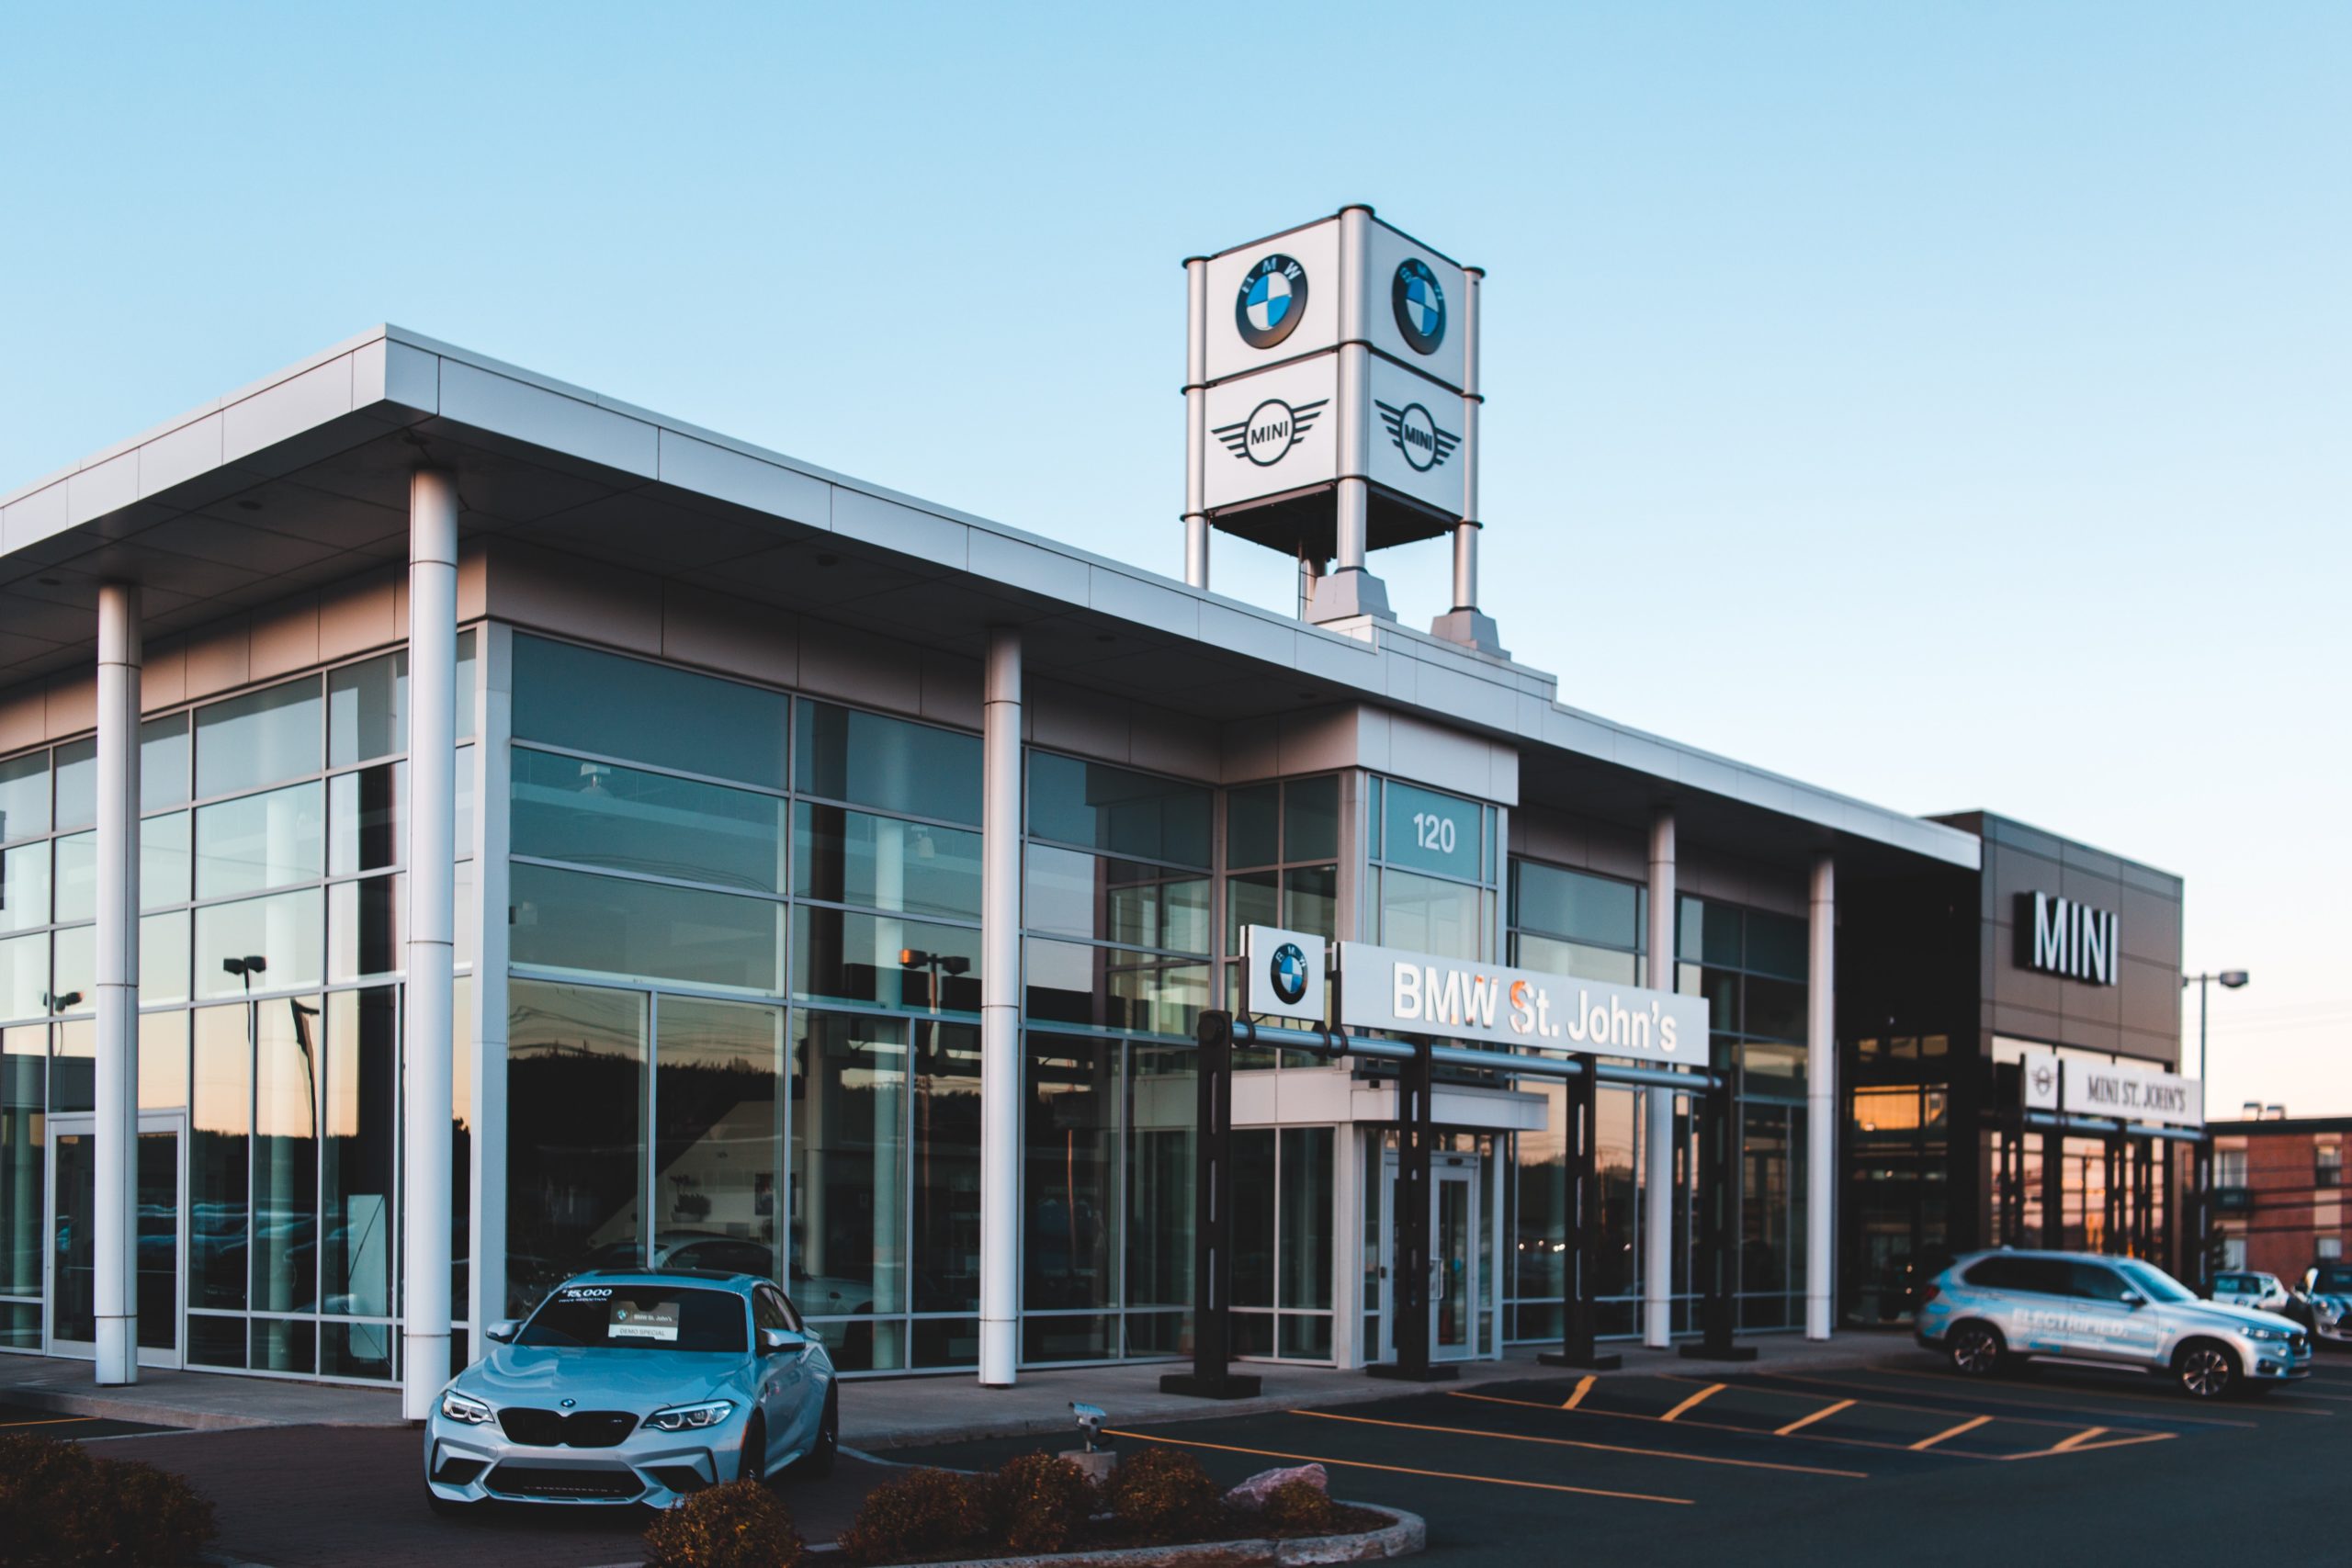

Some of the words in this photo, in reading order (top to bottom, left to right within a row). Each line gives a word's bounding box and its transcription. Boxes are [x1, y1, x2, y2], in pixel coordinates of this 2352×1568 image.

[1241, 257, 1302, 294] BMW
[1251, 421, 1288, 445] MINI
[1404, 423, 1432, 451] MINI
[1414, 812, 1455, 853] 120
[2034, 890, 2118, 987] MINI
[1393, 962, 1498, 1028] BMW
[1509, 980, 1559, 1037] St.
[1566, 989, 1678, 1053] John's
[2087, 1074, 2119, 1105] MINI
[2122, 1081, 2140, 1109] ST.
[2143, 1083, 2186, 1113] JOHN'S
